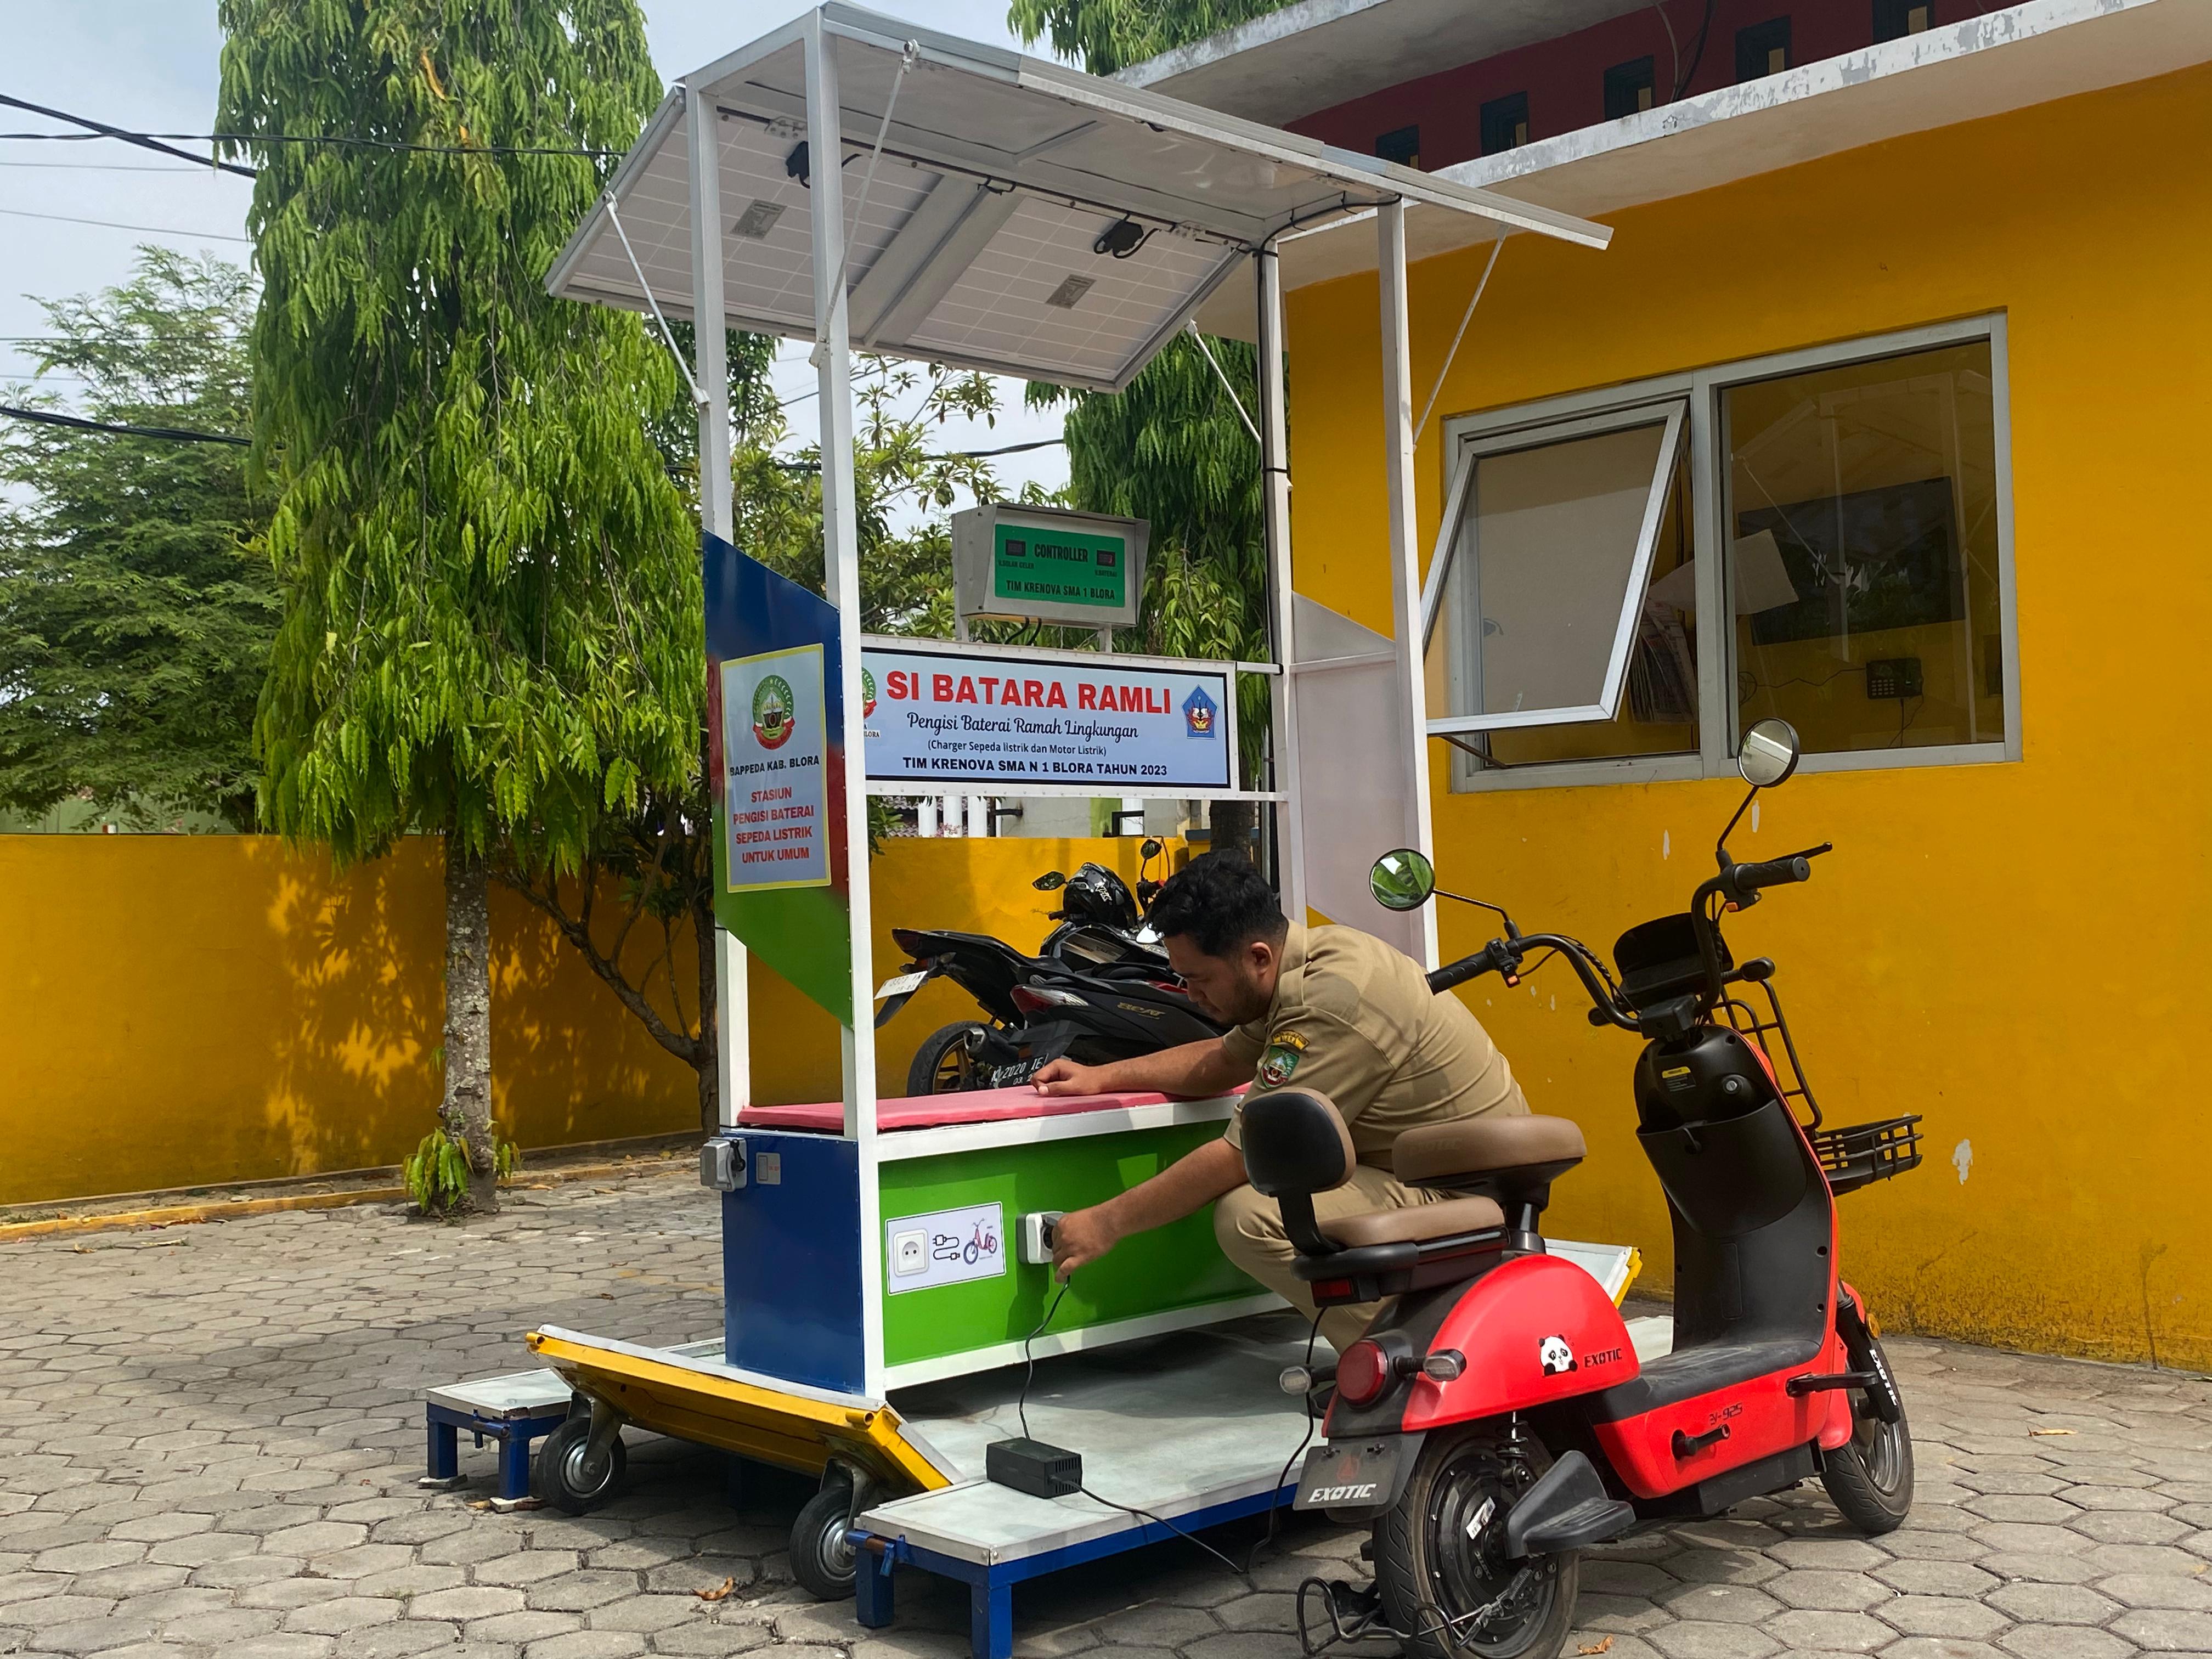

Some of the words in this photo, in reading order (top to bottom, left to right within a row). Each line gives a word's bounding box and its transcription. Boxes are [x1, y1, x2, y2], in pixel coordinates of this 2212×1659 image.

[1035, 544, 1088, 562] CONTROLLER
[1006, 580, 1022, 591] TIM
[1024, 582, 1061, 595] KRENOVA
[1063, 585, 1081, 596] SMA
[1084, 588, 1087, 597] 1
[1090, 588, 1115, 600] BLORA
[887, 670, 919, 701] SI
[933, 674, 1068, 709] BATARA
[1078, 683, 1171, 714] RAMLI
[907, 712, 958, 736] Pengisi
[961, 715, 1011, 733] Baterai
[1014, 718, 1062, 735] Ramah
[1064, 719, 1139, 743] Lingkungan
[928, 740, 967, 753] (Charger
[969, 741, 1001, 754] Sepeda
[1003, 742, 1029, 753] listrik
[1031, 743, 1047, 754] dan
[1049, 744, 1076, 755] Motor
[1078, 746, 1107, 757] Listrik)
[730, 763, 765, 776] BAPPEDA
[767, 760, 787, 771] KAB.
[789, 755, 819, 768] BLORA
[903, 757, 927, 769] TIM
[932, 758, 995, 771] KRENOVA
[998, 760, 1026, 771] SMA
[1030, 761, 1038, 772] N
[1042, 761, 1048, 772] 1
[1053, 762, 1093, 774] BLORA
[1097, 763, 1137, 775] TAHUN
[1141, 764, 1167, 776] 2023
[751, 787, 792, 803] STASIUN
[733, 810, 769, 825] PENGISI
[771, 805, 814, 821] BATERAI
[736, 830, 771, 844] SEPEDA
[773, 826, 813, 841] LISTRIK
[742, 850, 776, 864] UNTUK
[777, 847, 810, 860] UMUM
[1002, 1062, 1027, 1079] 2020
[1584, 1348, 1622, 1368] EXOTIC
[1869, 1349, 1897, 1406] EXOTIC
[1308, 1483, 1377, 1503] EXOTIC
